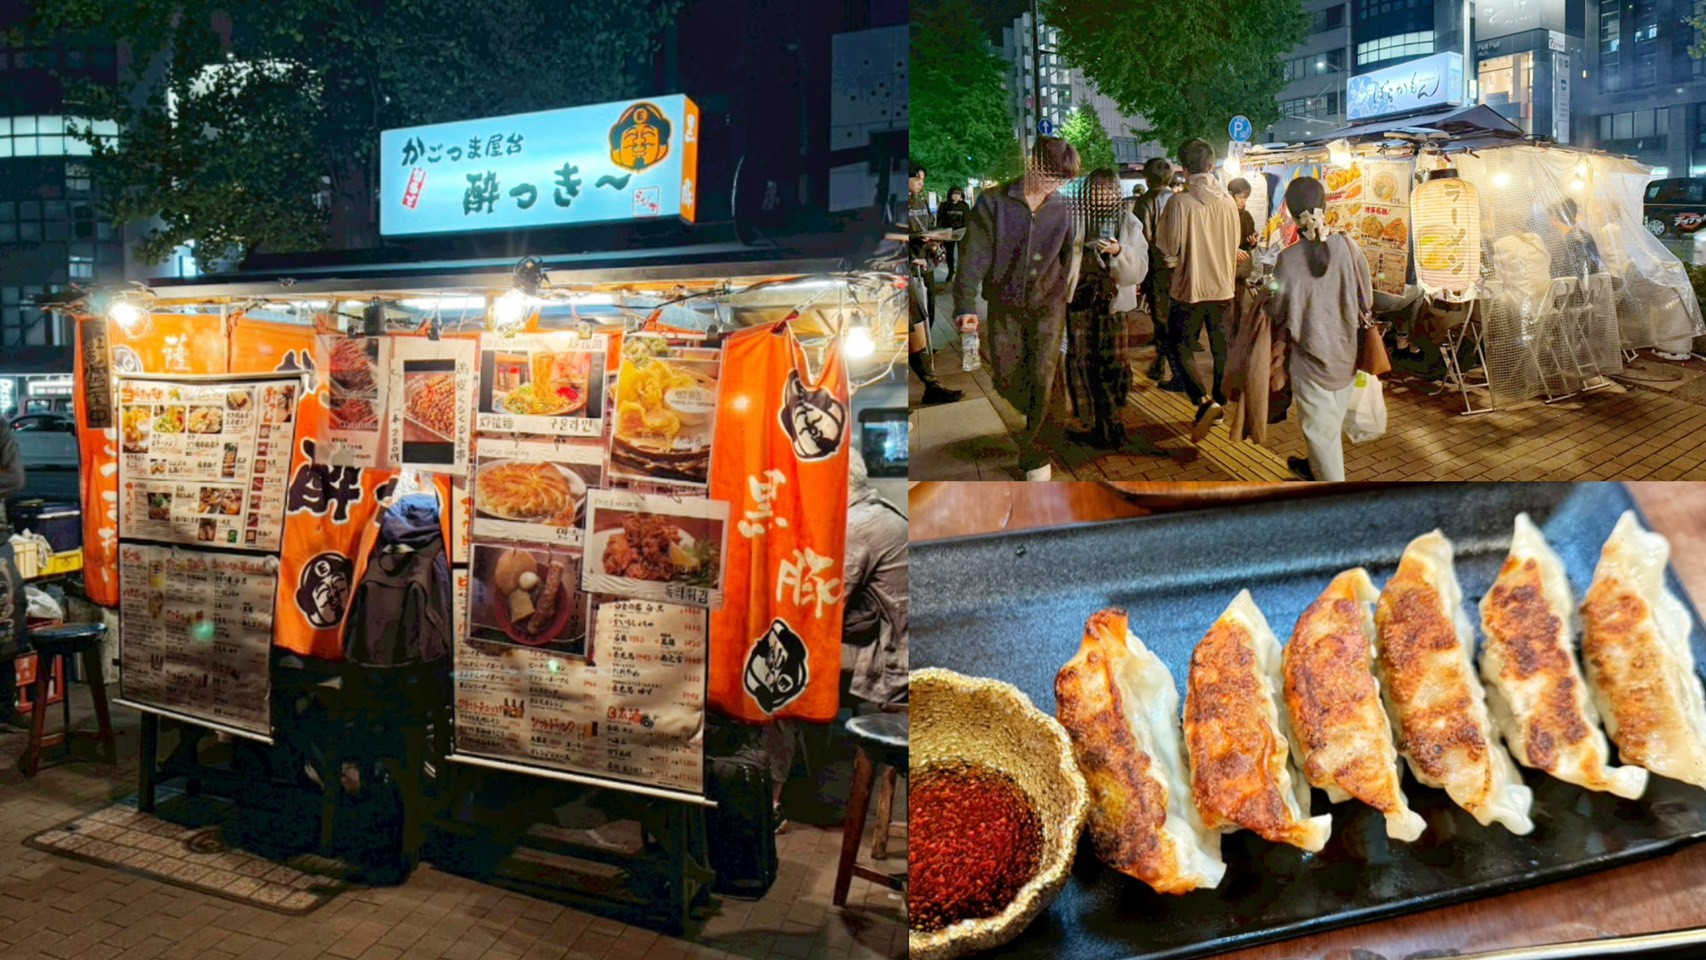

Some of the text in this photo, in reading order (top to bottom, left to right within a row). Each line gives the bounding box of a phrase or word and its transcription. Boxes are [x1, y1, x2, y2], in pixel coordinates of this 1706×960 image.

[1234, 121, 1243, 138] P
[1443, 183, 1467, 276] ラーメン
[607, 705, 642, 723] 日本酒
